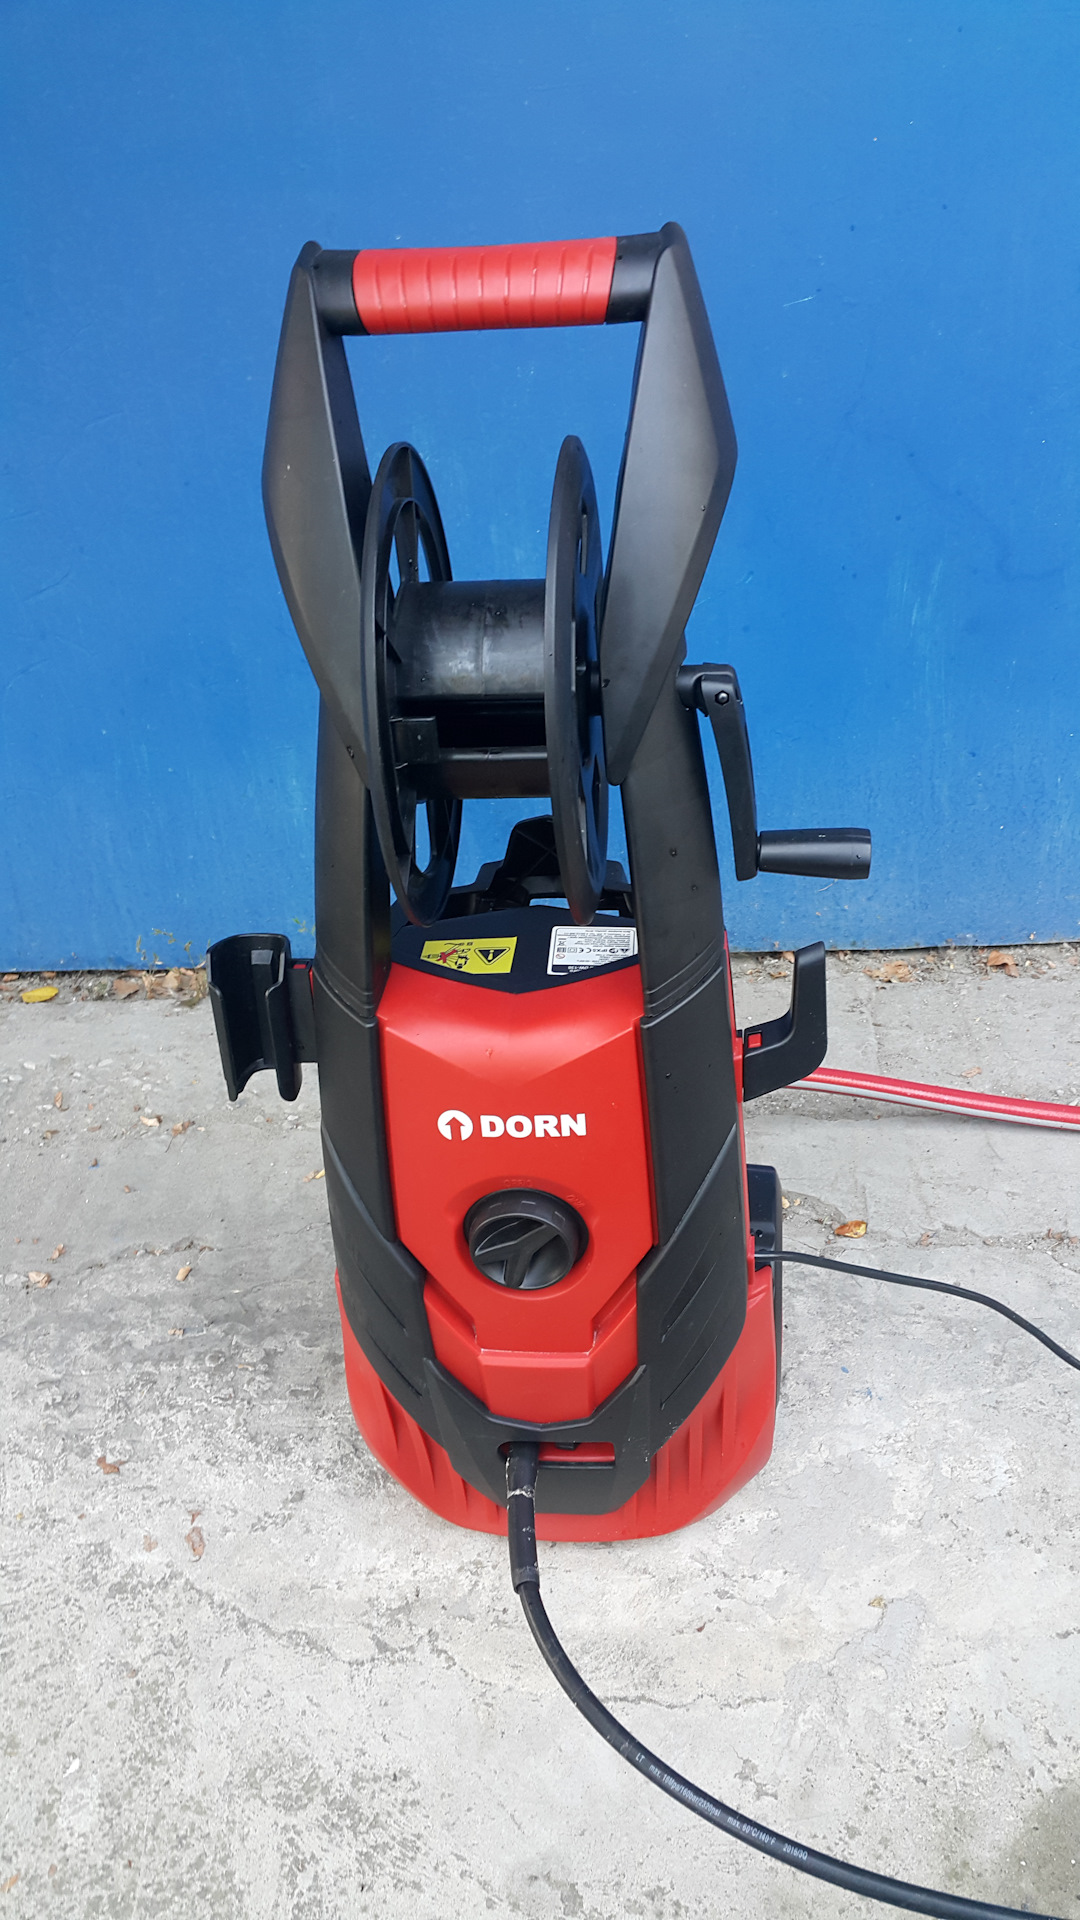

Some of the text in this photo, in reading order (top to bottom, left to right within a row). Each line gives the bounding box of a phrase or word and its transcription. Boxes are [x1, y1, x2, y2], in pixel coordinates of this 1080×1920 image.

[480, 1113, 587, 1138] DORN
[635, 1753, 646, 1763] LT
[649, 1764, 661, 1778] max.
[727, 1816, 741, 1829] max.
